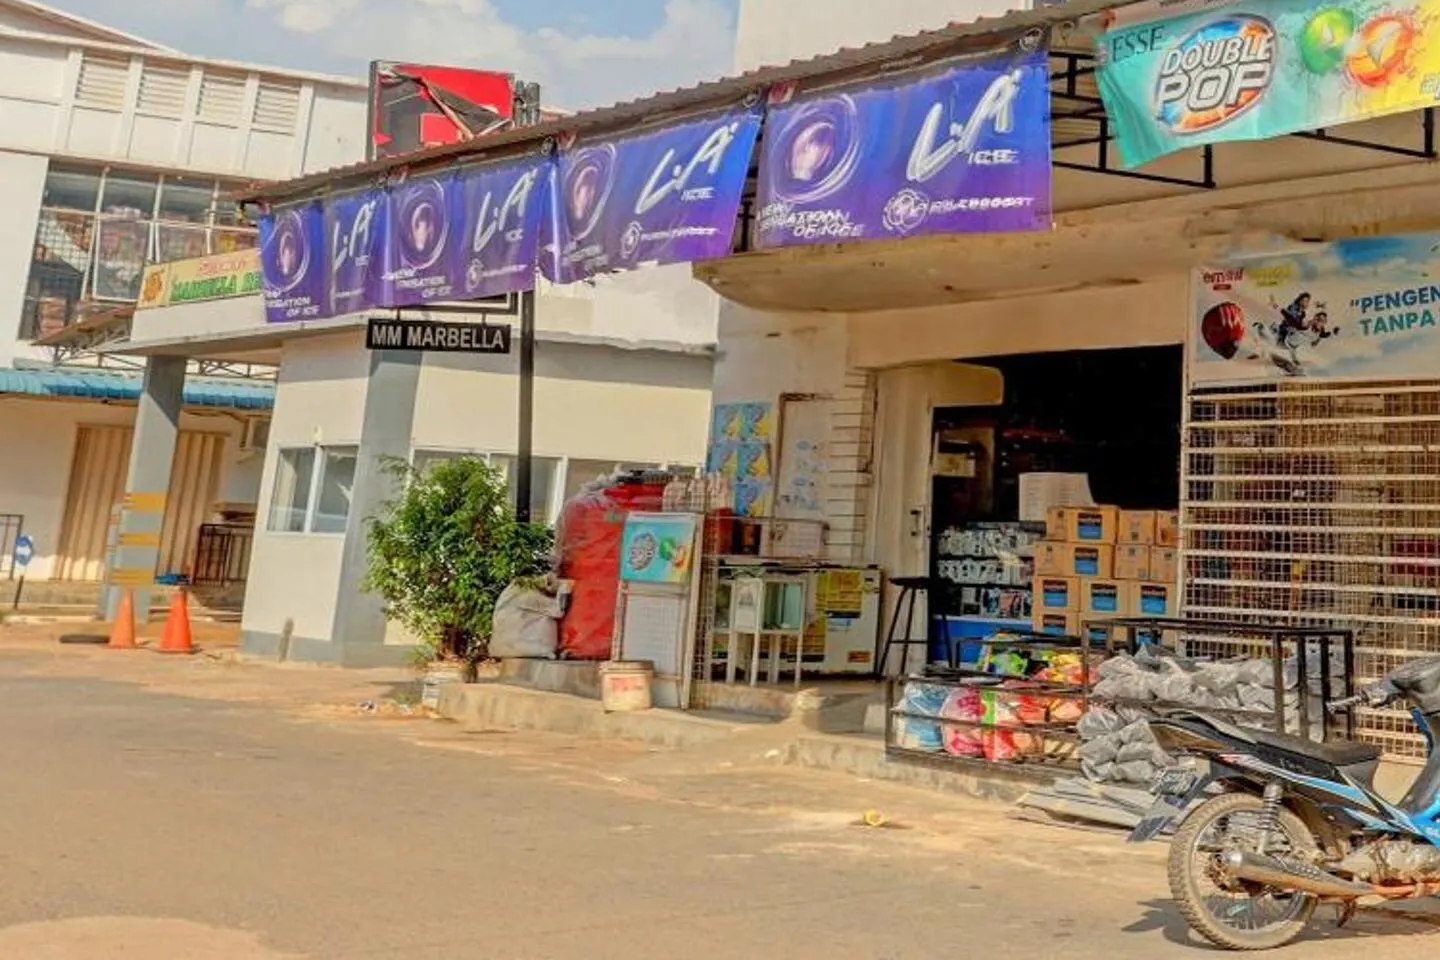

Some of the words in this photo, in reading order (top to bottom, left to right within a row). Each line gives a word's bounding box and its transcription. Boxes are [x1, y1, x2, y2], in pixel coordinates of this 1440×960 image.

[1112, 25, 1164, 63] ESSE
[1161, 38, 1274, 78] DOUBLE
[1158, 60, 1271, 111] POP
[372, 324, 401, 347] MM
[406, 325, 505, 350] MARBELLA
[1360, 307, 1436, 337] TANPA
